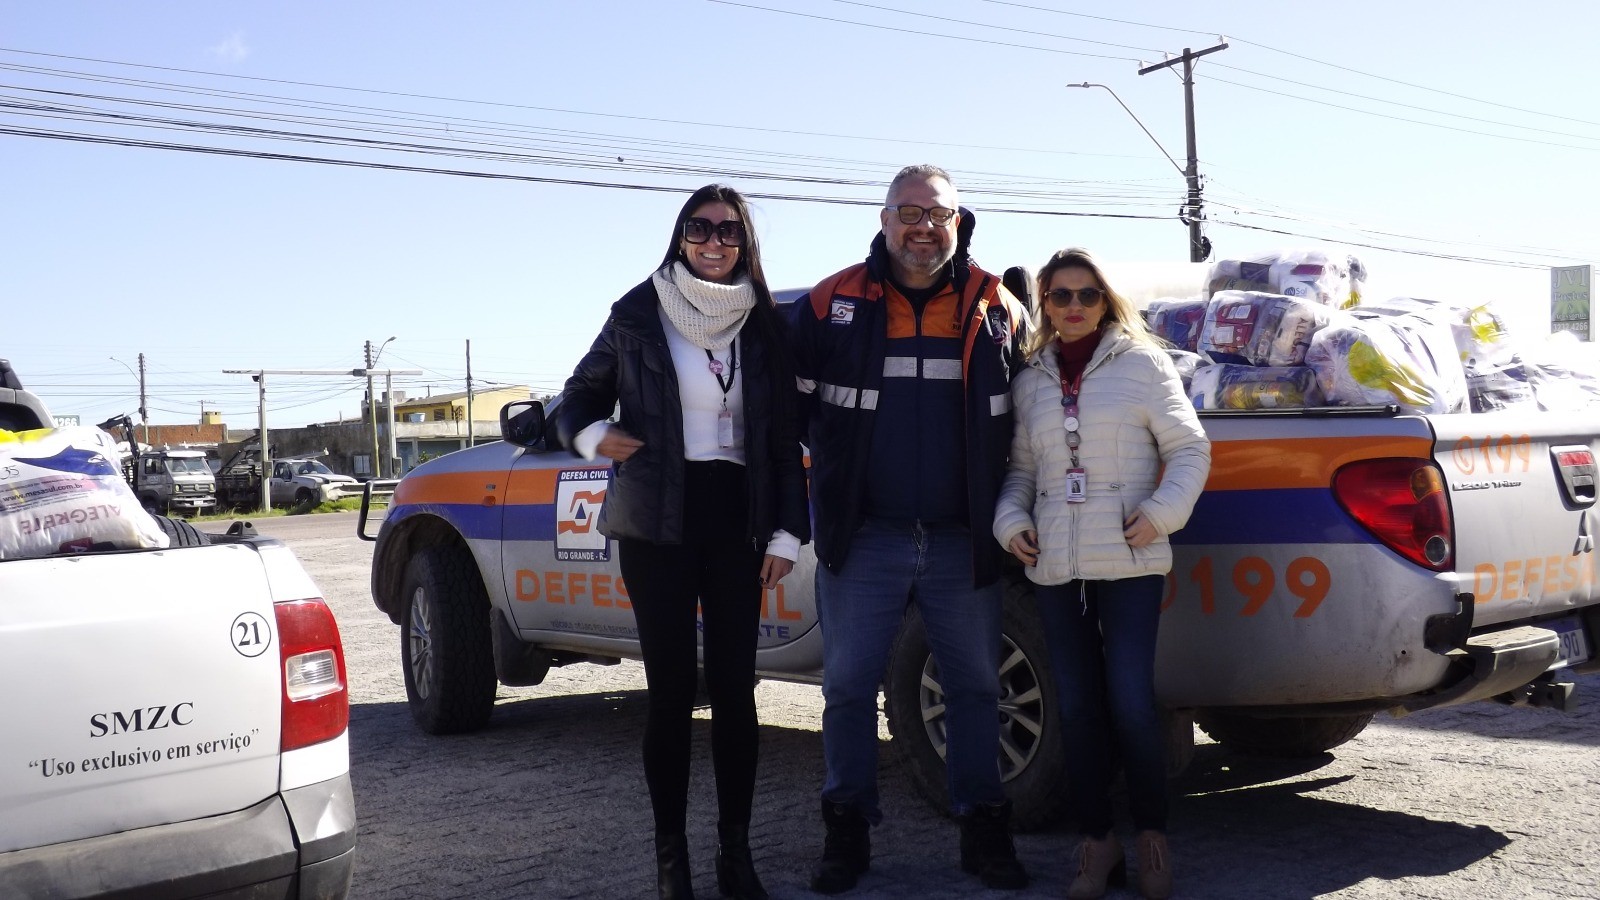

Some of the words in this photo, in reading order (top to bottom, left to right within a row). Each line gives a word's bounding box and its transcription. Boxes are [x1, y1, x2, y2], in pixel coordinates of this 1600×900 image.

[560, 470, 588, 480] DEFESA
[589, 470, 609, 479] CIVIL
[2, 483, 83, 502] www.mesasul.com.br
[558, 551, 569, 560] RIO
[569, 551, 595, 560] GRANDE
[515, 569, 634, 610] DEFES
[1190, 556, 1332, 618] 199
[1473, 550, 1598, 604] DEFESA
[236, 621, 262, 646] 21
[90, 701, 194, 738] SMZC
[81, 747, 161, 772] exclusivo
[167, 744, 191, 760] em
